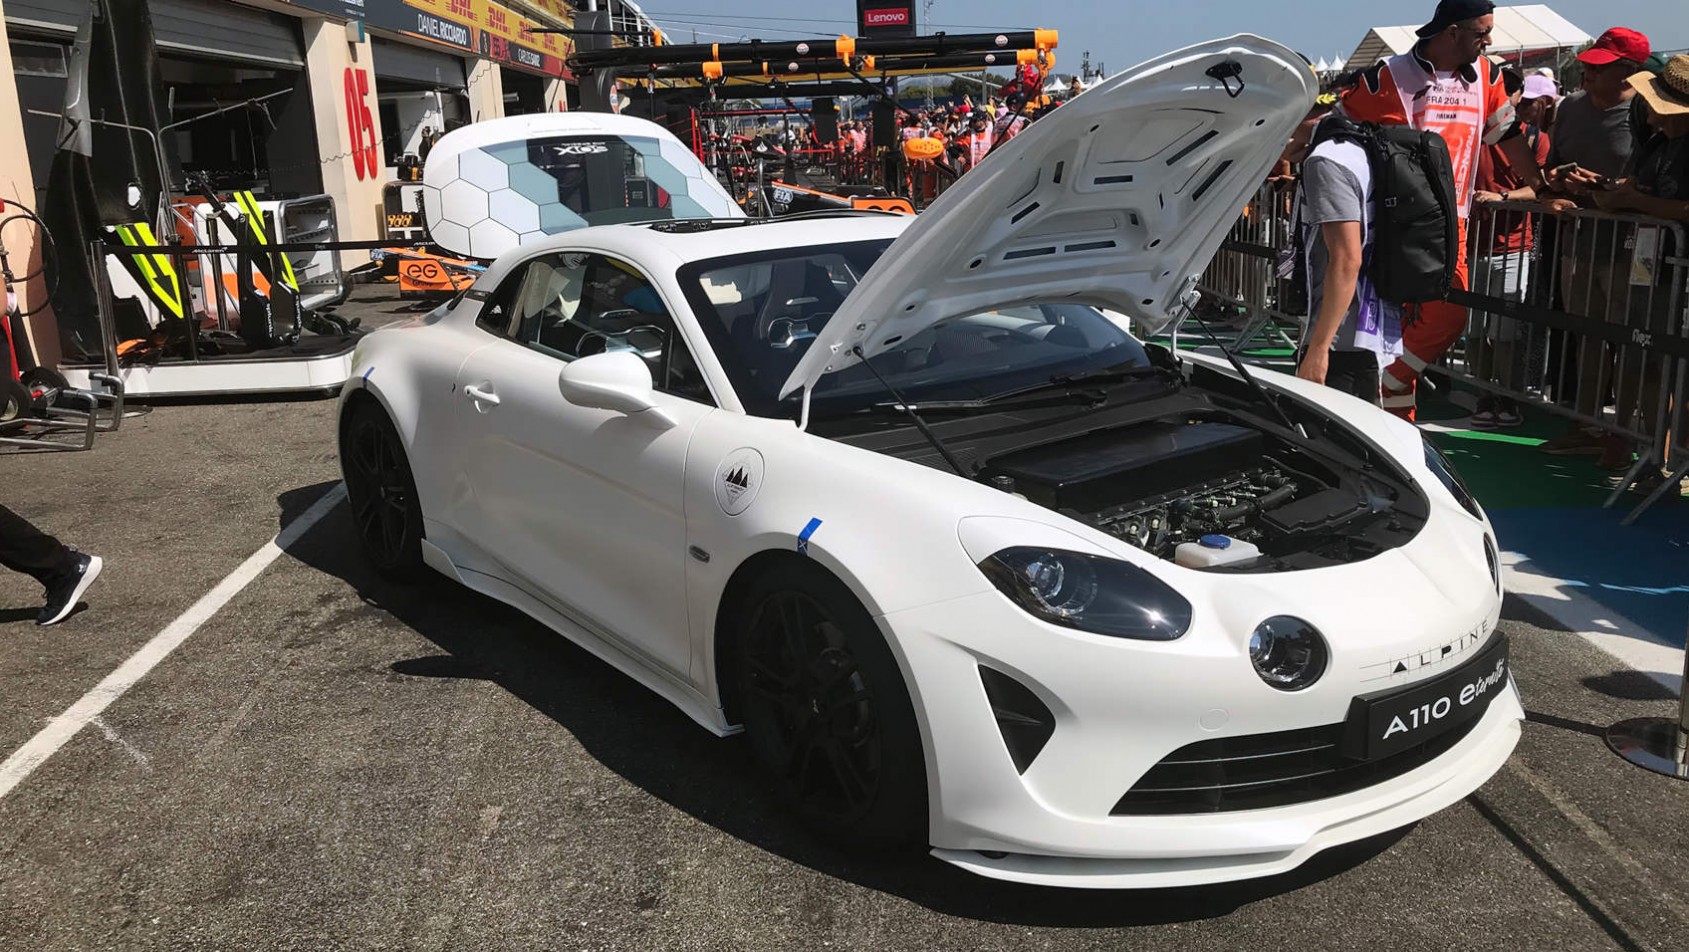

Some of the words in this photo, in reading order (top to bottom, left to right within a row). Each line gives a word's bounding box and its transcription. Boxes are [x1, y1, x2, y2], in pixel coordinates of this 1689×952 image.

[867, 13, 905, 23] Lenovo
[417, 13, 440, 38] DANIEL
[1426, 95, 1443, 104] FRA
[1443, 96, 1460, 105] 204
[344, 67, 378, 182] 05
[774, 191, 791, 203] FIA
[192, 246, 227, 254] McLaren
[371, 252, 384, 260] FIA
[1382, 696, 1451, 741] A110
